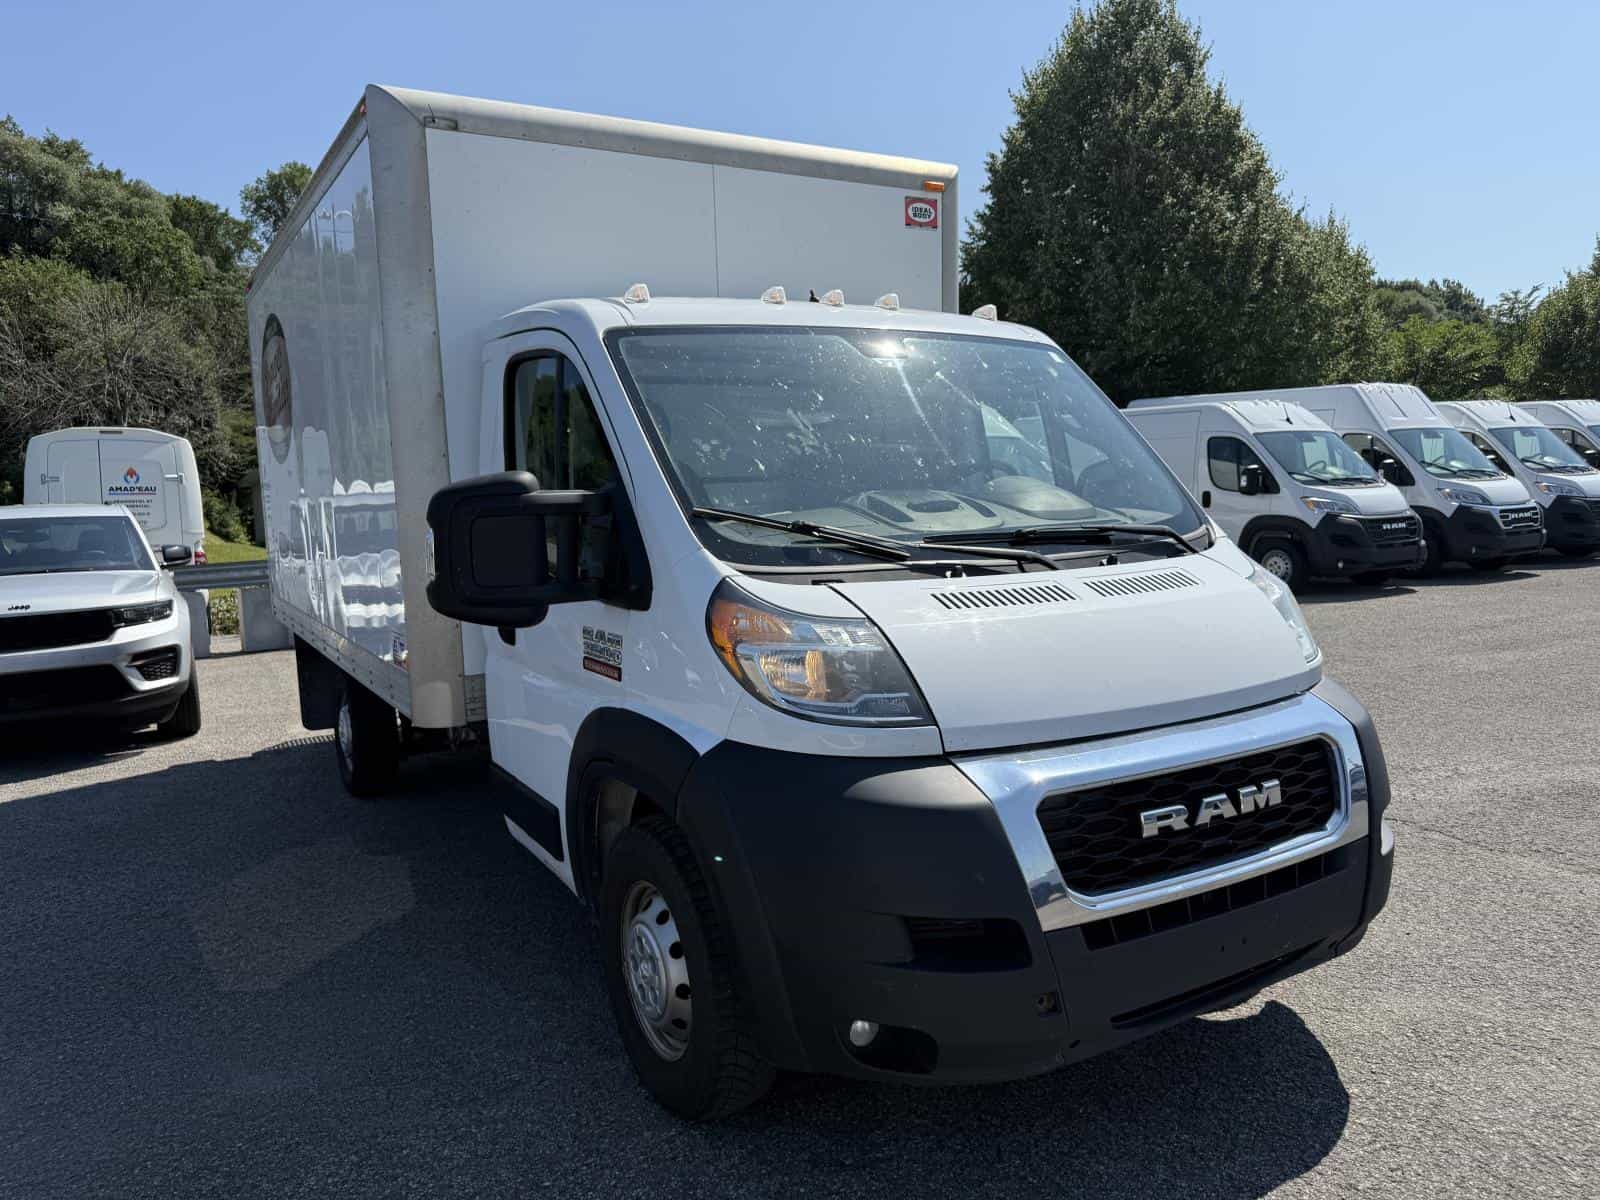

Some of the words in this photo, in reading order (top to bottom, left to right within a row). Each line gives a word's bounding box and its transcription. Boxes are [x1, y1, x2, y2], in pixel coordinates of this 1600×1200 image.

[911, 206, 933, 214] IDEAL
[1382, 522, 1406, 530] RAM
[1140, 778, 1282, 838] RAM
